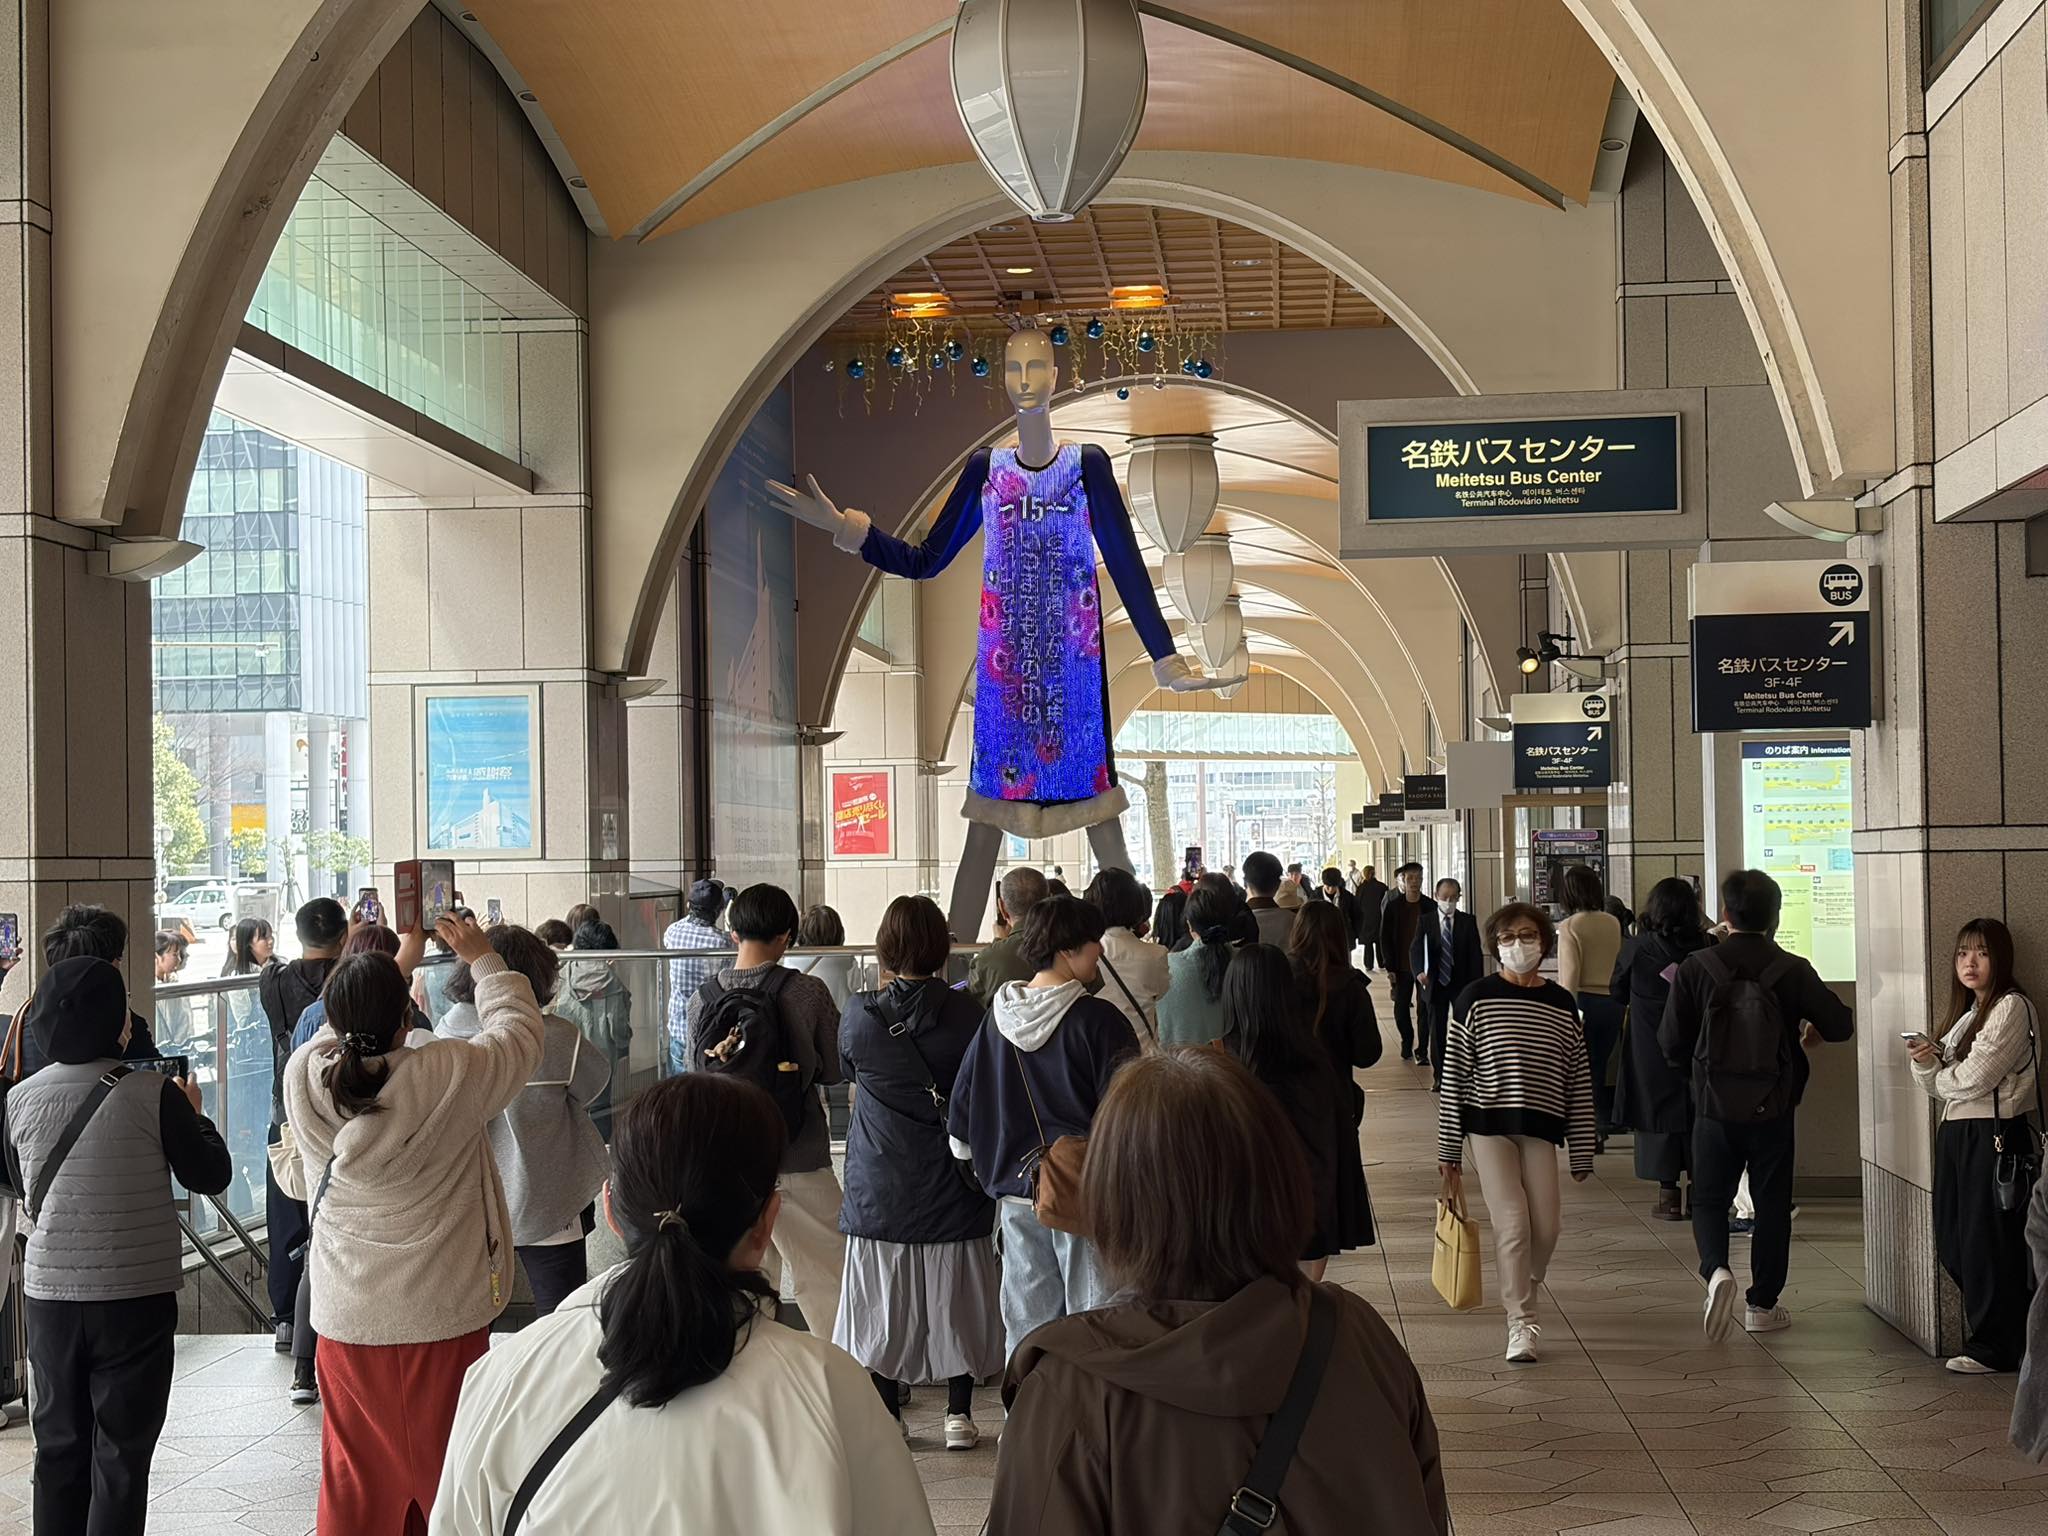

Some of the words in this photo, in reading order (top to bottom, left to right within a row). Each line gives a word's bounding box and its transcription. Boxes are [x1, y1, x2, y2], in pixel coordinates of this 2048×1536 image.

[1400, 435, 1636, 470] 名鉄バスセンター
[1436, 472, 1505, 488] Meitetsu
[1510, 471, 1542, 486] Bus
[1547, 469, 1602, 484] Center
[1461, 498, 1496, 507] Terminal
[1498, 496, 1542, 506] Rodoviário
[1544, 496, 1579, 505] Meitetsu
[1830, 591, 1852, 600] BUS
[1718, 656, 1848, 674] 名鉄バスセンター
[1744, 691, 1777, 700] Meitetsu
[1779, 691, 1795, 699] Bus
[1797, 690, 1823, 699] Center
[1526, 746, 1598, 757] 名鉄バスセンター
[1765, 745, 1809, 755] のりば案内
